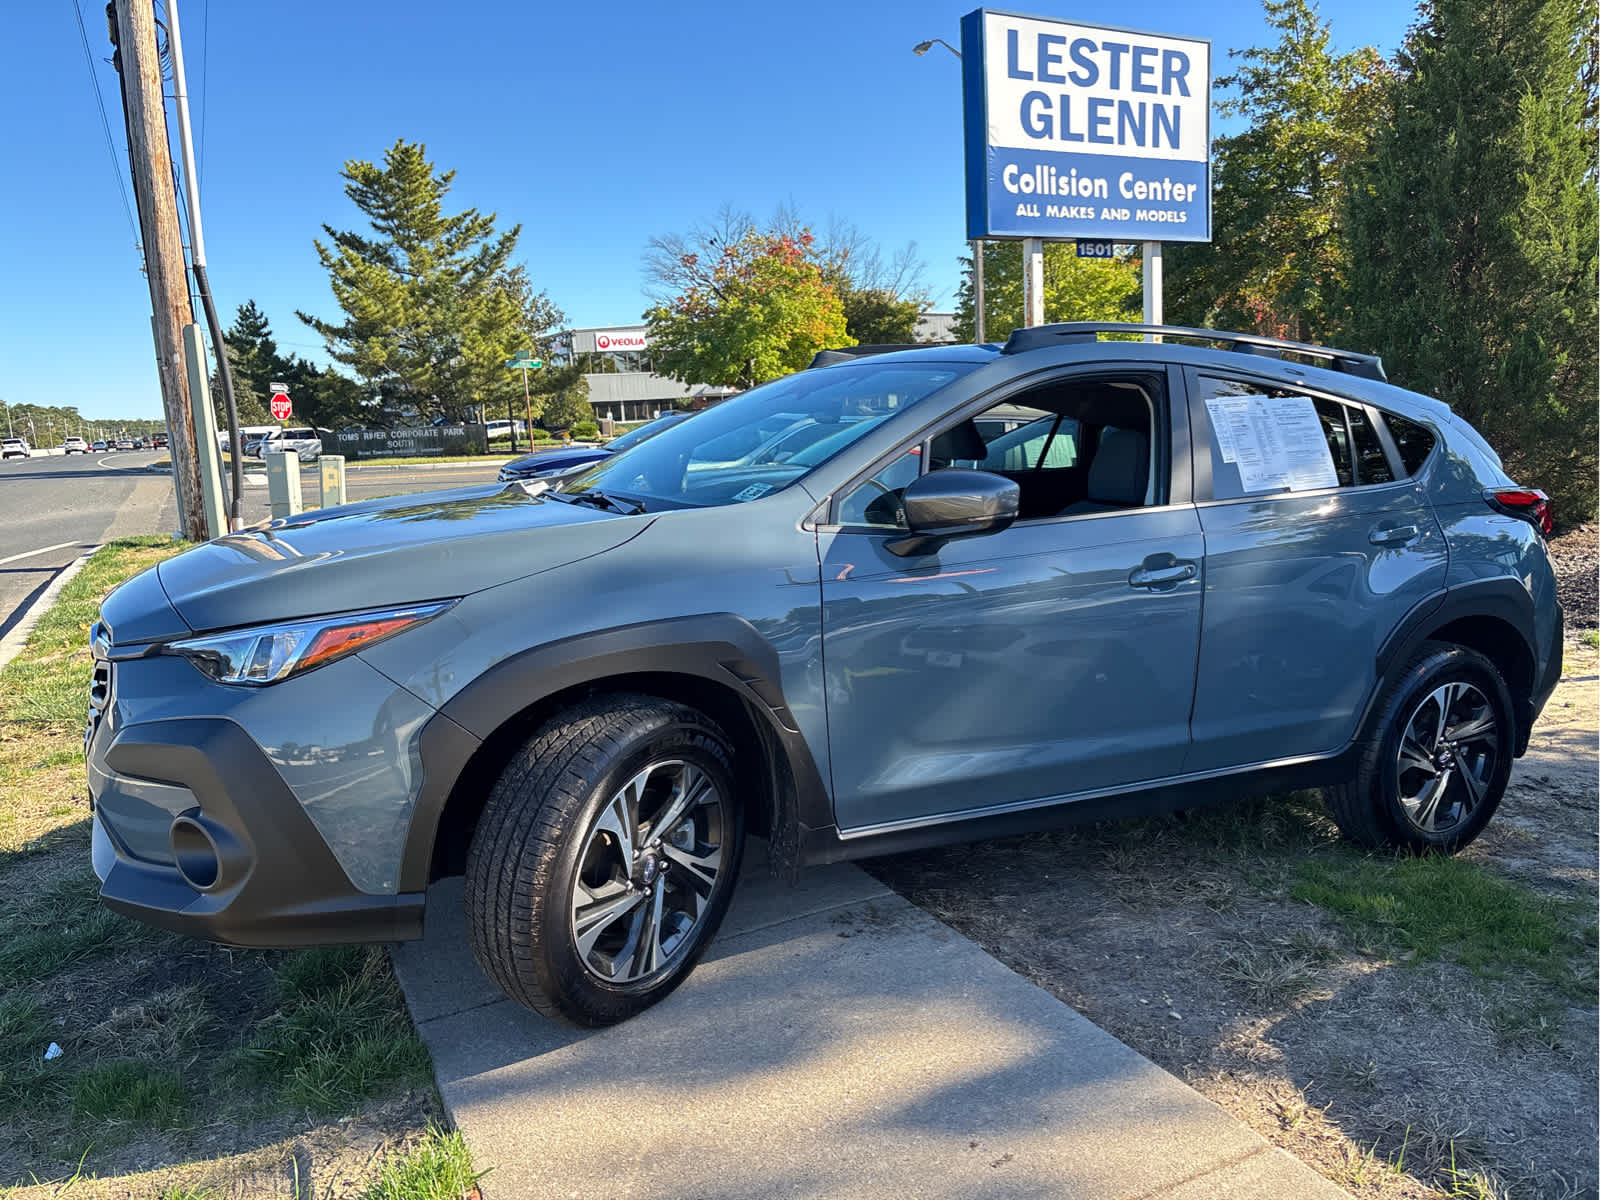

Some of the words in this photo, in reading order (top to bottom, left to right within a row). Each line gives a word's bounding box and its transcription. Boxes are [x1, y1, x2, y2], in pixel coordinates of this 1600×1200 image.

[1007, 29, 1191, 97] LESTER
[1020, 90, 1181, 150] GLENN
[1003, 164, 1108, 199] Collision
[1119, 172, 1197, 202] Center
[1016, 204, 1041, 217] ALL
[1046, 205, 1095, 219] MAKES
[1101, 207, 1130, 221] AND
[1136, 209, 1187, 223] MODELS
[1079, 243, 1112, 256] 1501
[611, 338, 645, 346] VEOLIA
[272, 401, 290, 412] STOP
[337, 433, 359, 441] TOMS
[363, 431, 387, 440] RIVER
[390, 429, 439, 439] CORPORATE
[443, 427, 465, 436] PARK
[387, 440, 414, 448] SOUTH
